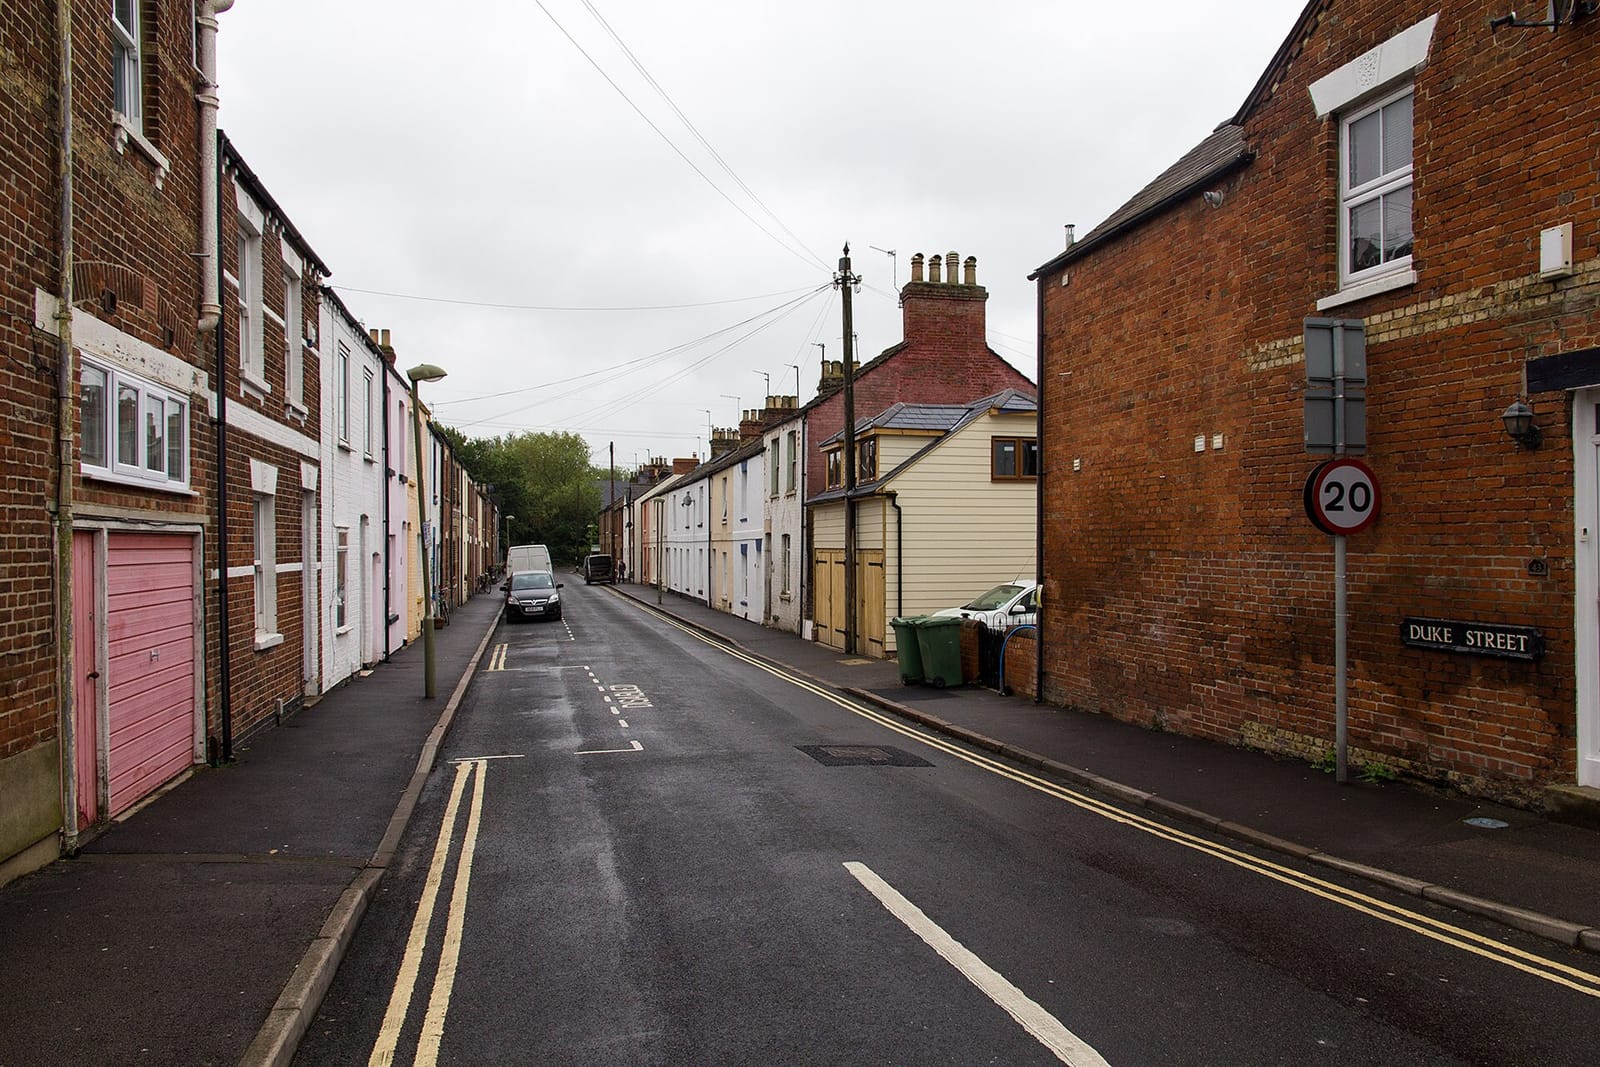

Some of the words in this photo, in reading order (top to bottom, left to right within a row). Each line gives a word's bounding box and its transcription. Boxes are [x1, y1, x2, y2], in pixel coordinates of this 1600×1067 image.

[1324, 481, 1371, 512] 20
[1409, 624, 1453, 643] DUKE
[1466, 630, 1528, 652] STREET
